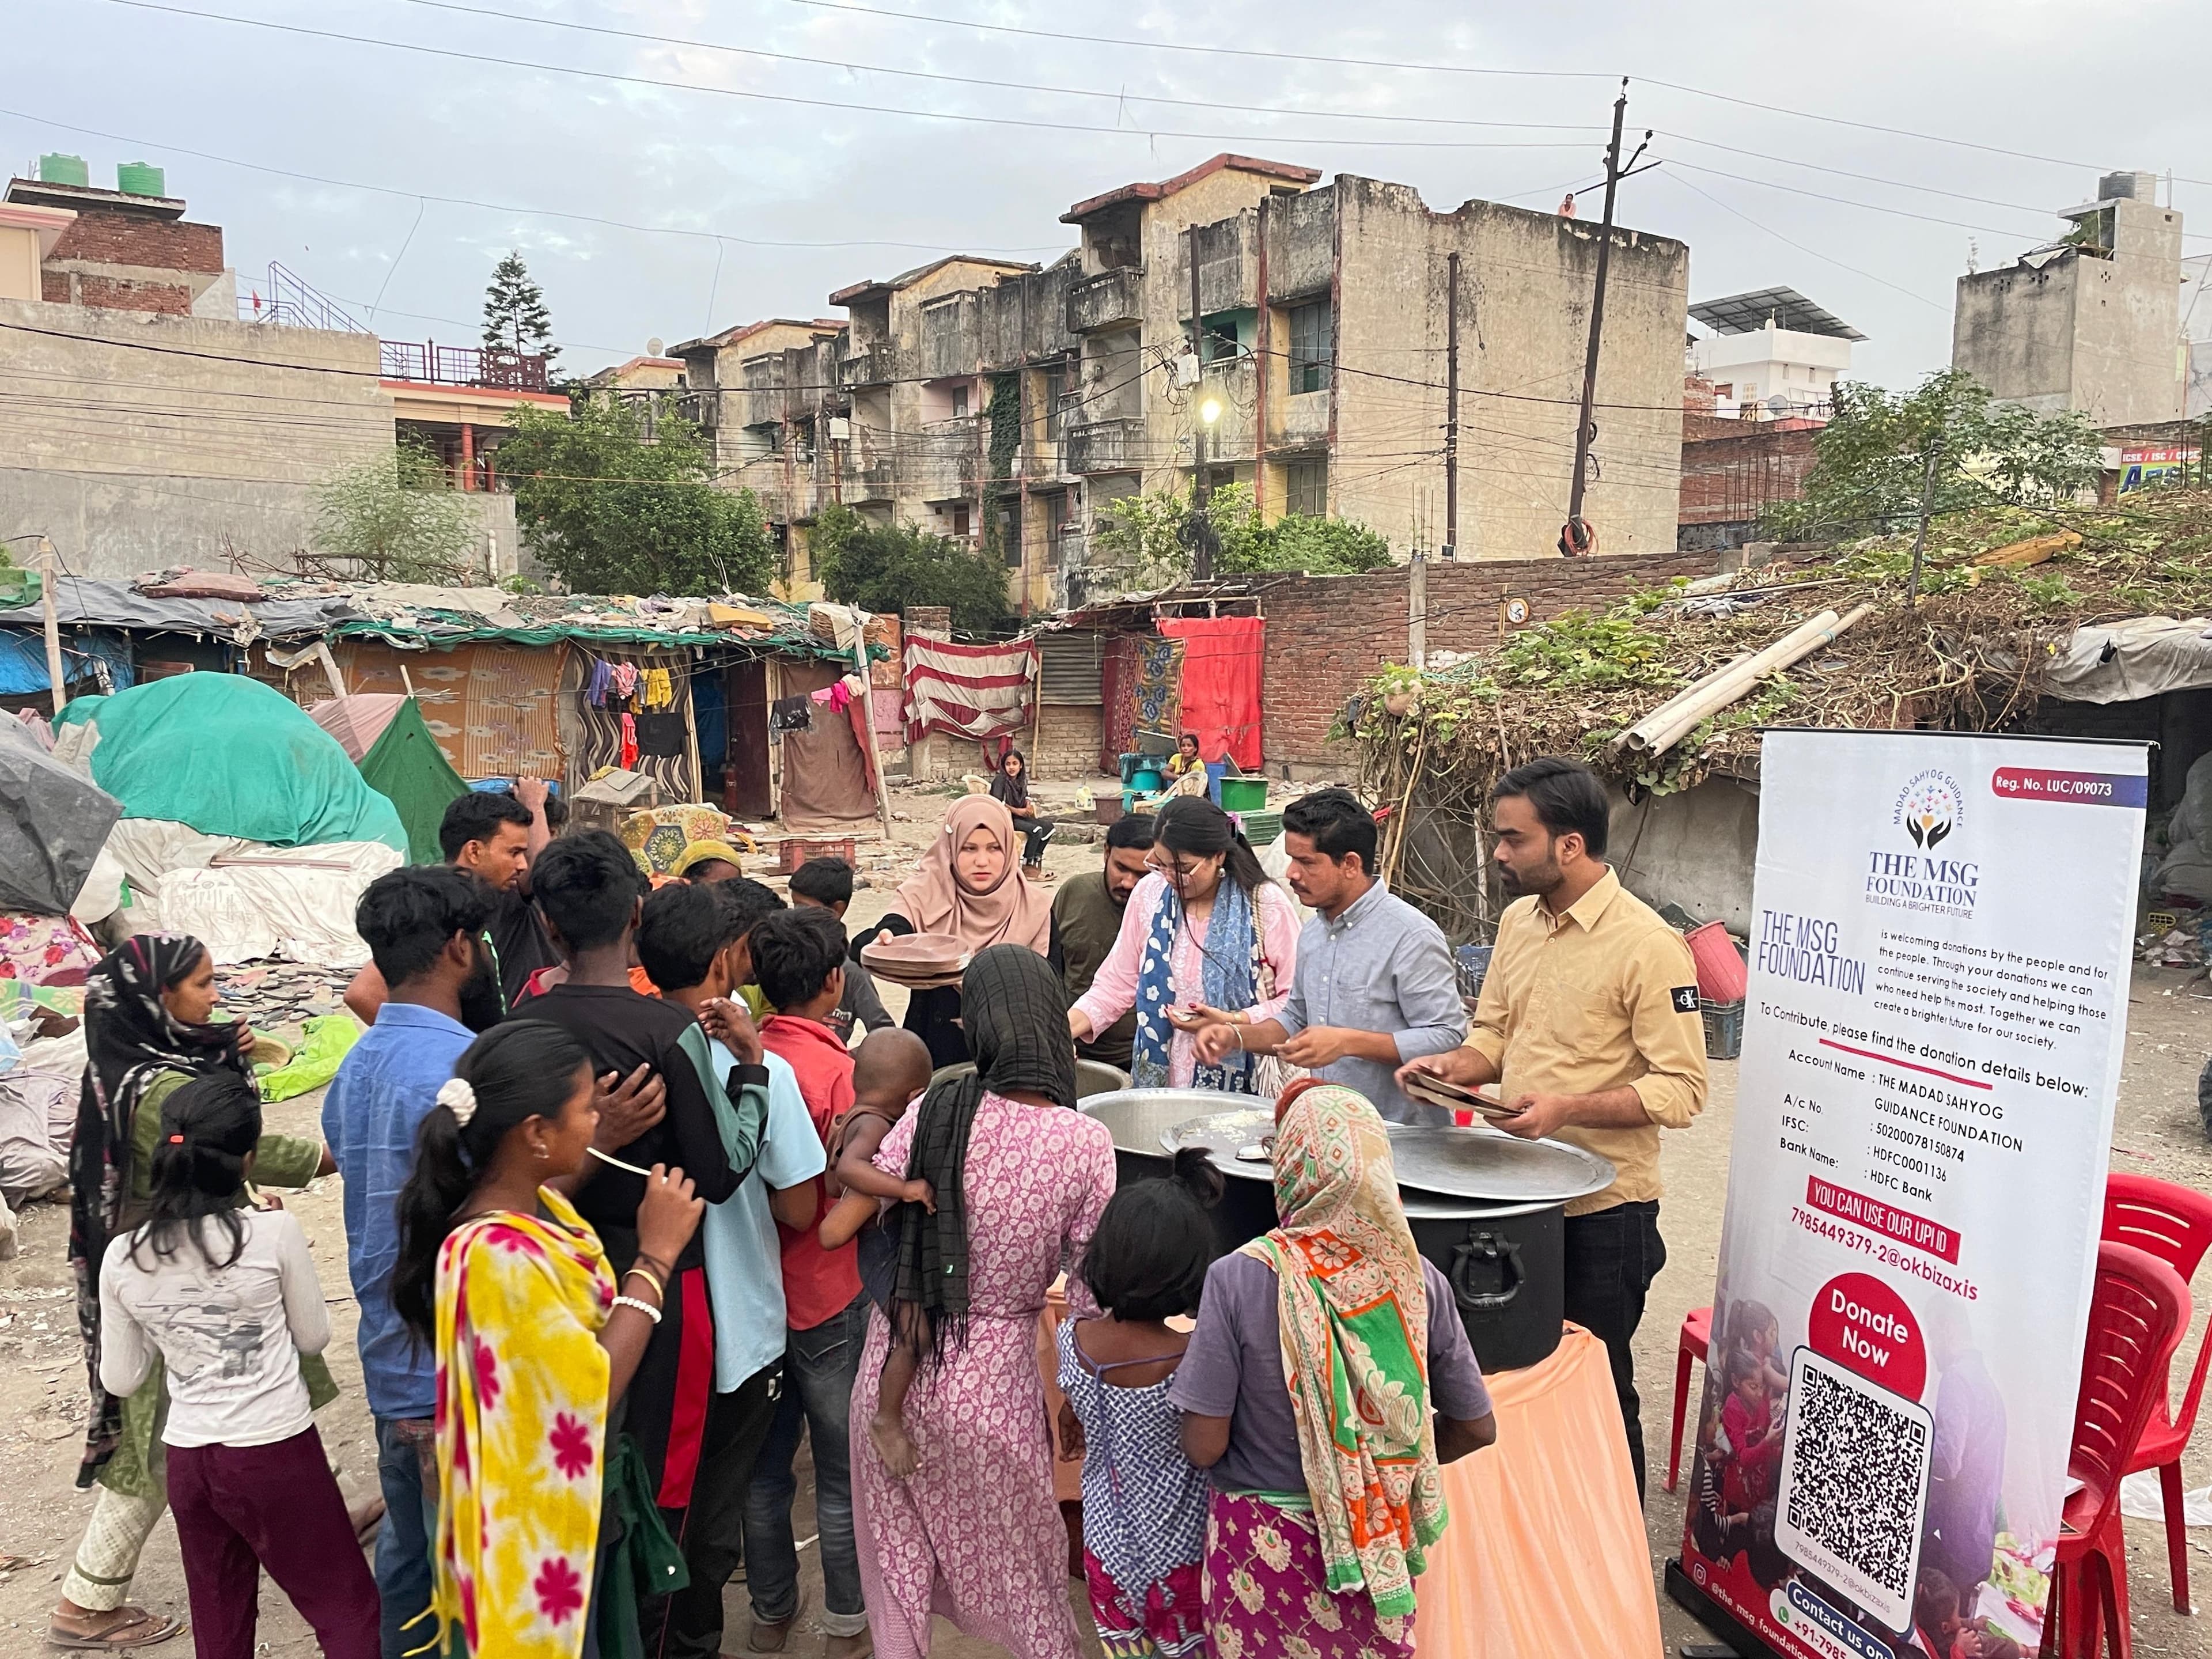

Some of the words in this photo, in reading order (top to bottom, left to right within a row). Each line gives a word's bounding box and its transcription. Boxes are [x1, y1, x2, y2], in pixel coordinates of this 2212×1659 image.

[2151, 452, 2166, 461] ISC
[1893, 787, 1910, 824] MADAD
[1910, 769, 1944, 787] SAHYOG
[1945, 776, 1963, 828] GUIDANCE
[1996, 776, 2020, 791] Reg.
[2024, 778, 2043, 790] No.
[2047, 779, 2112, 796] LUC/09073
[1866, 876, 1976, 907] FOUNDATION
[1870, 851, 1917, 878] THE
[1922, 858, 1979, 887] MSG
[1763, 910, 1793, 945] THE
[1796, 917, 1838, 954] MSG
[1866, 894, 1901, 908] BUILDING
[1908, 901, 1945, 915] BRIGHTER
[1946, 906, 1973, 919] FUTURE
[1758, 941, 1865, 995] FOUNDATION
[1880, 946, 1893, 957] the
[1896, 953, 1929, 964] people.
[1933, 956, 1964, 973] Through
[1968, 965, 1993, 977] your
[1997, 969, 2047, 987] donations
[2051, 981, 2067, 991] we
[2071, 986, 2093, 996] can
[1881, 929, 1888, 939] is
[1891, 931, 1939, 950] welcoming
[1942, 940, 1987, 957] donations
[1991, 949, 2004, 962] by
[2008, 951, 2022, 963] the
[2026, 957, 2065, 971] people
[2069, 965, 2091, 976] and
[2094, 967, 2108, 979] for
[1876, 983, 1894, 994] who
[1896, 987, 1918, 999] need
[1921, 991, 1942, 1006] help
[1944, 995, 1955, 1007] the
[1958, 1002, 1986, 1014] most.
[1990, 1006, 2036, 1024] Together
[2039, 1018, 2054, 1028] we
[2059, 1023, 2081, 1035] can
[1878, 966, 1914, 980] continue
[1916, 974, 1949, 989] serving
[1952, 978, 1964, 990] the
[1967, 984, 2007, 1001] society
[2010, 993, 2030, 1003] and
[2033, 995, 2074, 1015] helping
[2078, 1003, 2106, 1020] those
[1761, 1002, 1771, 1015] To
[1773, 1006, 1830, 1032] Contribute,
[1832, 1022, 1868, 1041] please
[1872, 1031, 1893, 1048] find
[1897, 1037, 1915, 1054] the
[1920, 1044, 1976, 1070] donation
[1982, 1060, 2031, 1083] details
[2036, 1071, 2089, 1098] below:
[1874, 1001, 1901, 1013] create
[1911, 1007, 1948, 1022] brighter
[1949, 1016, 1974, 1029] future
[1978, 1022, 1993, 1035] for
[1996, 1029, 2013, 1039] our
[2016, 1033, 2056, 1050] society.
[1788, 1049, 1832, 1070] Account
[1835, 1061, 1865, 1080] Name
[1878, 1074, 1896, 1090] THE
[1898, 1080, 1943, 1103] MADAD
[1946, 1093, 2003, 1119] SAHYOG
[1782, 1115, 1809, 1132] IFSC:
[1873, 1146, 1946, 1182] HDFC0001136
[1784, 1093, 1805, 1108] A/c
[1809, 1100, 1823, 1115] No.
[1876, 1123, 1964, 1162] 50200078150874
[1874, 1097, 1936, 1126] GUIDANCE
[1938, 1116, 2022, 1152] FOUNDATION
[1780, 1137, 1807, 1156] Bank
[1809, 1146, 1839, 1168] Name:
[1870, 1169, 1899, 1190] HDFC
[1902, 1181, 1932, 1202] Bank
[1815, 1182, 1835, 1208] YOU
[1837, 1192, 1862, 1219] CAN
[1863, 1201, 1886, 1228] USE
[1887, 1211, 1912, 1239] OUR
[1915, 1220, 1935, 1248] UPI
[1936, 1230, 1947, 1253] ID
[1791, 1207, 1978, 1301] 7985449379-2@okbizaxis
[1831, 1288, 1908, 1343] Donate
[1842, 1325, 1890, 1368] Now
[1793, 1588, 1844, 1637] Contact
[1847, 1630, 1862, 1649] us
